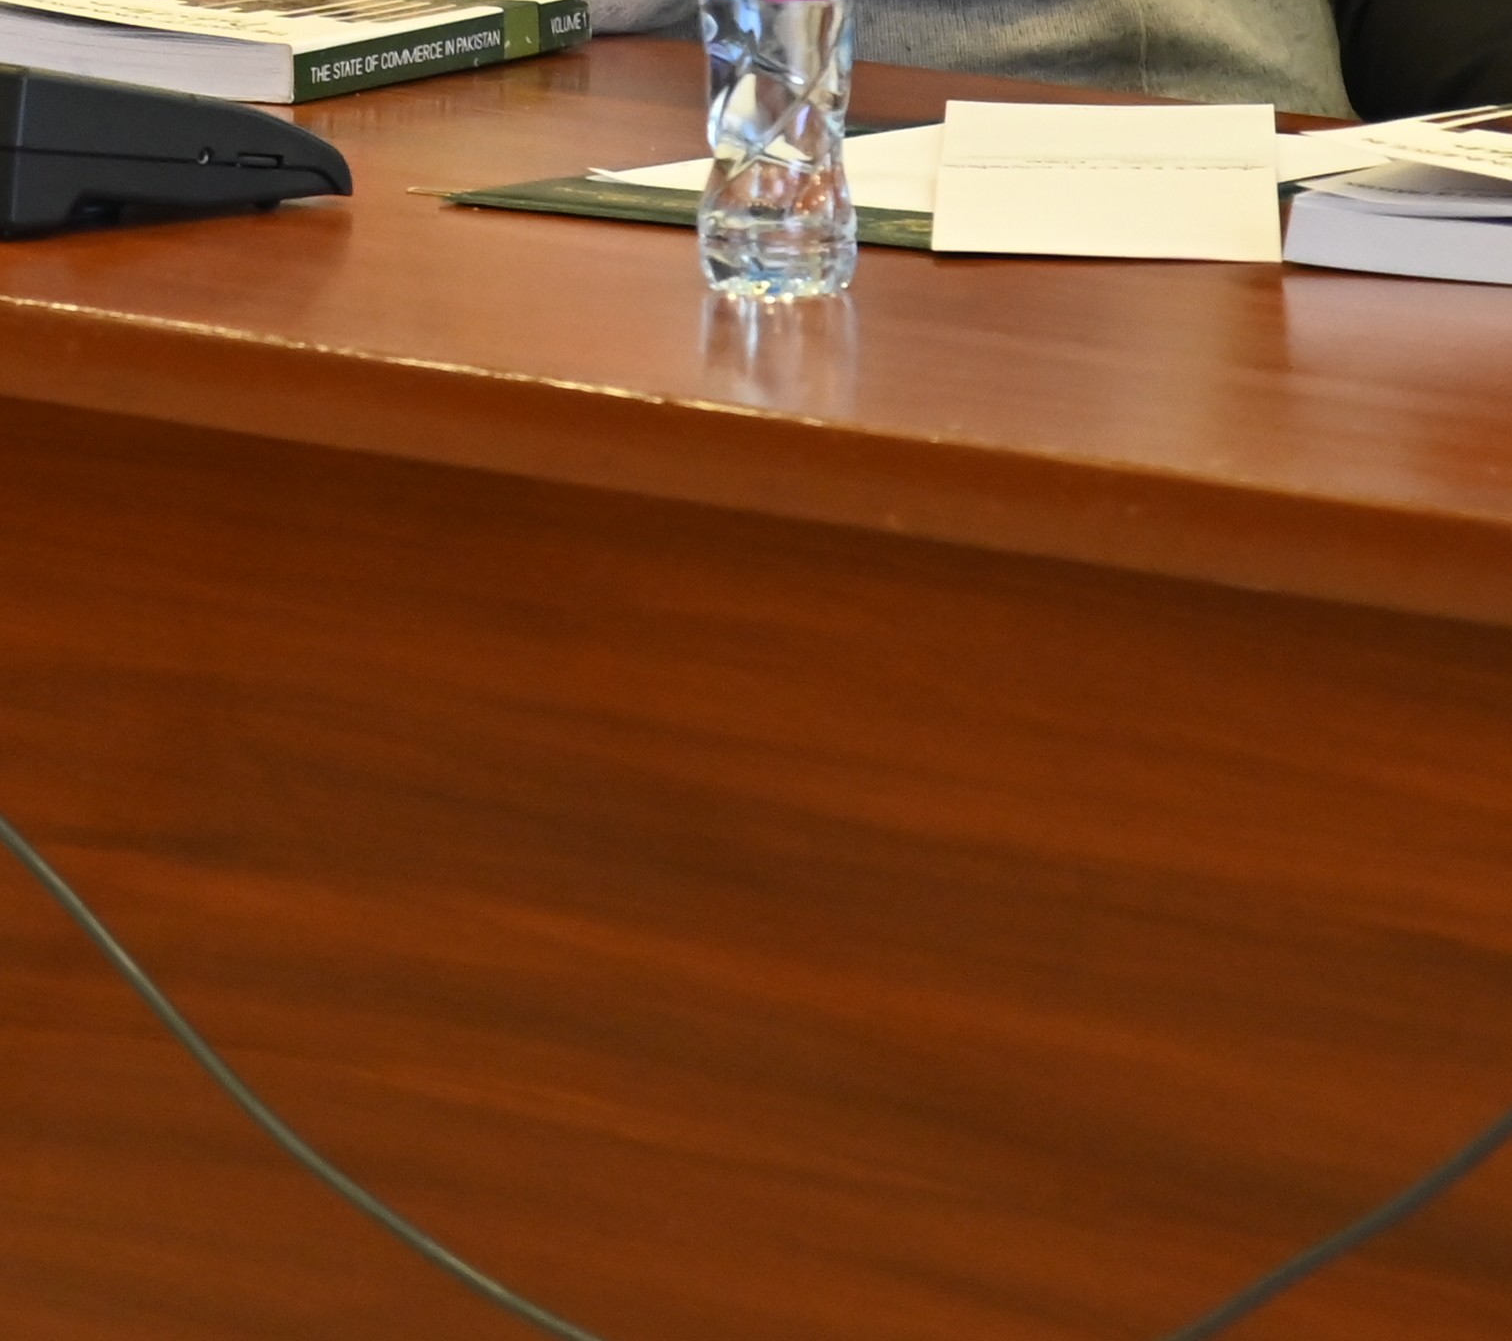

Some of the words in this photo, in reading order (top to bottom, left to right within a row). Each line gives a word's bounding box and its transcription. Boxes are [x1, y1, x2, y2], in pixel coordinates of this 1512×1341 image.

[550, 12, 581, 34] VOLUME
[582, 11, 587, 28] 1
[311, 64, 331, 84] THE
[333, 57, 363, 80] STATE
[365, 56, 379, 73] OF
[380, 41, 444, 69] COMMERCE
[445, 39, 455, 56] IN
[456, 29, 501, 54] PAKISTAN
